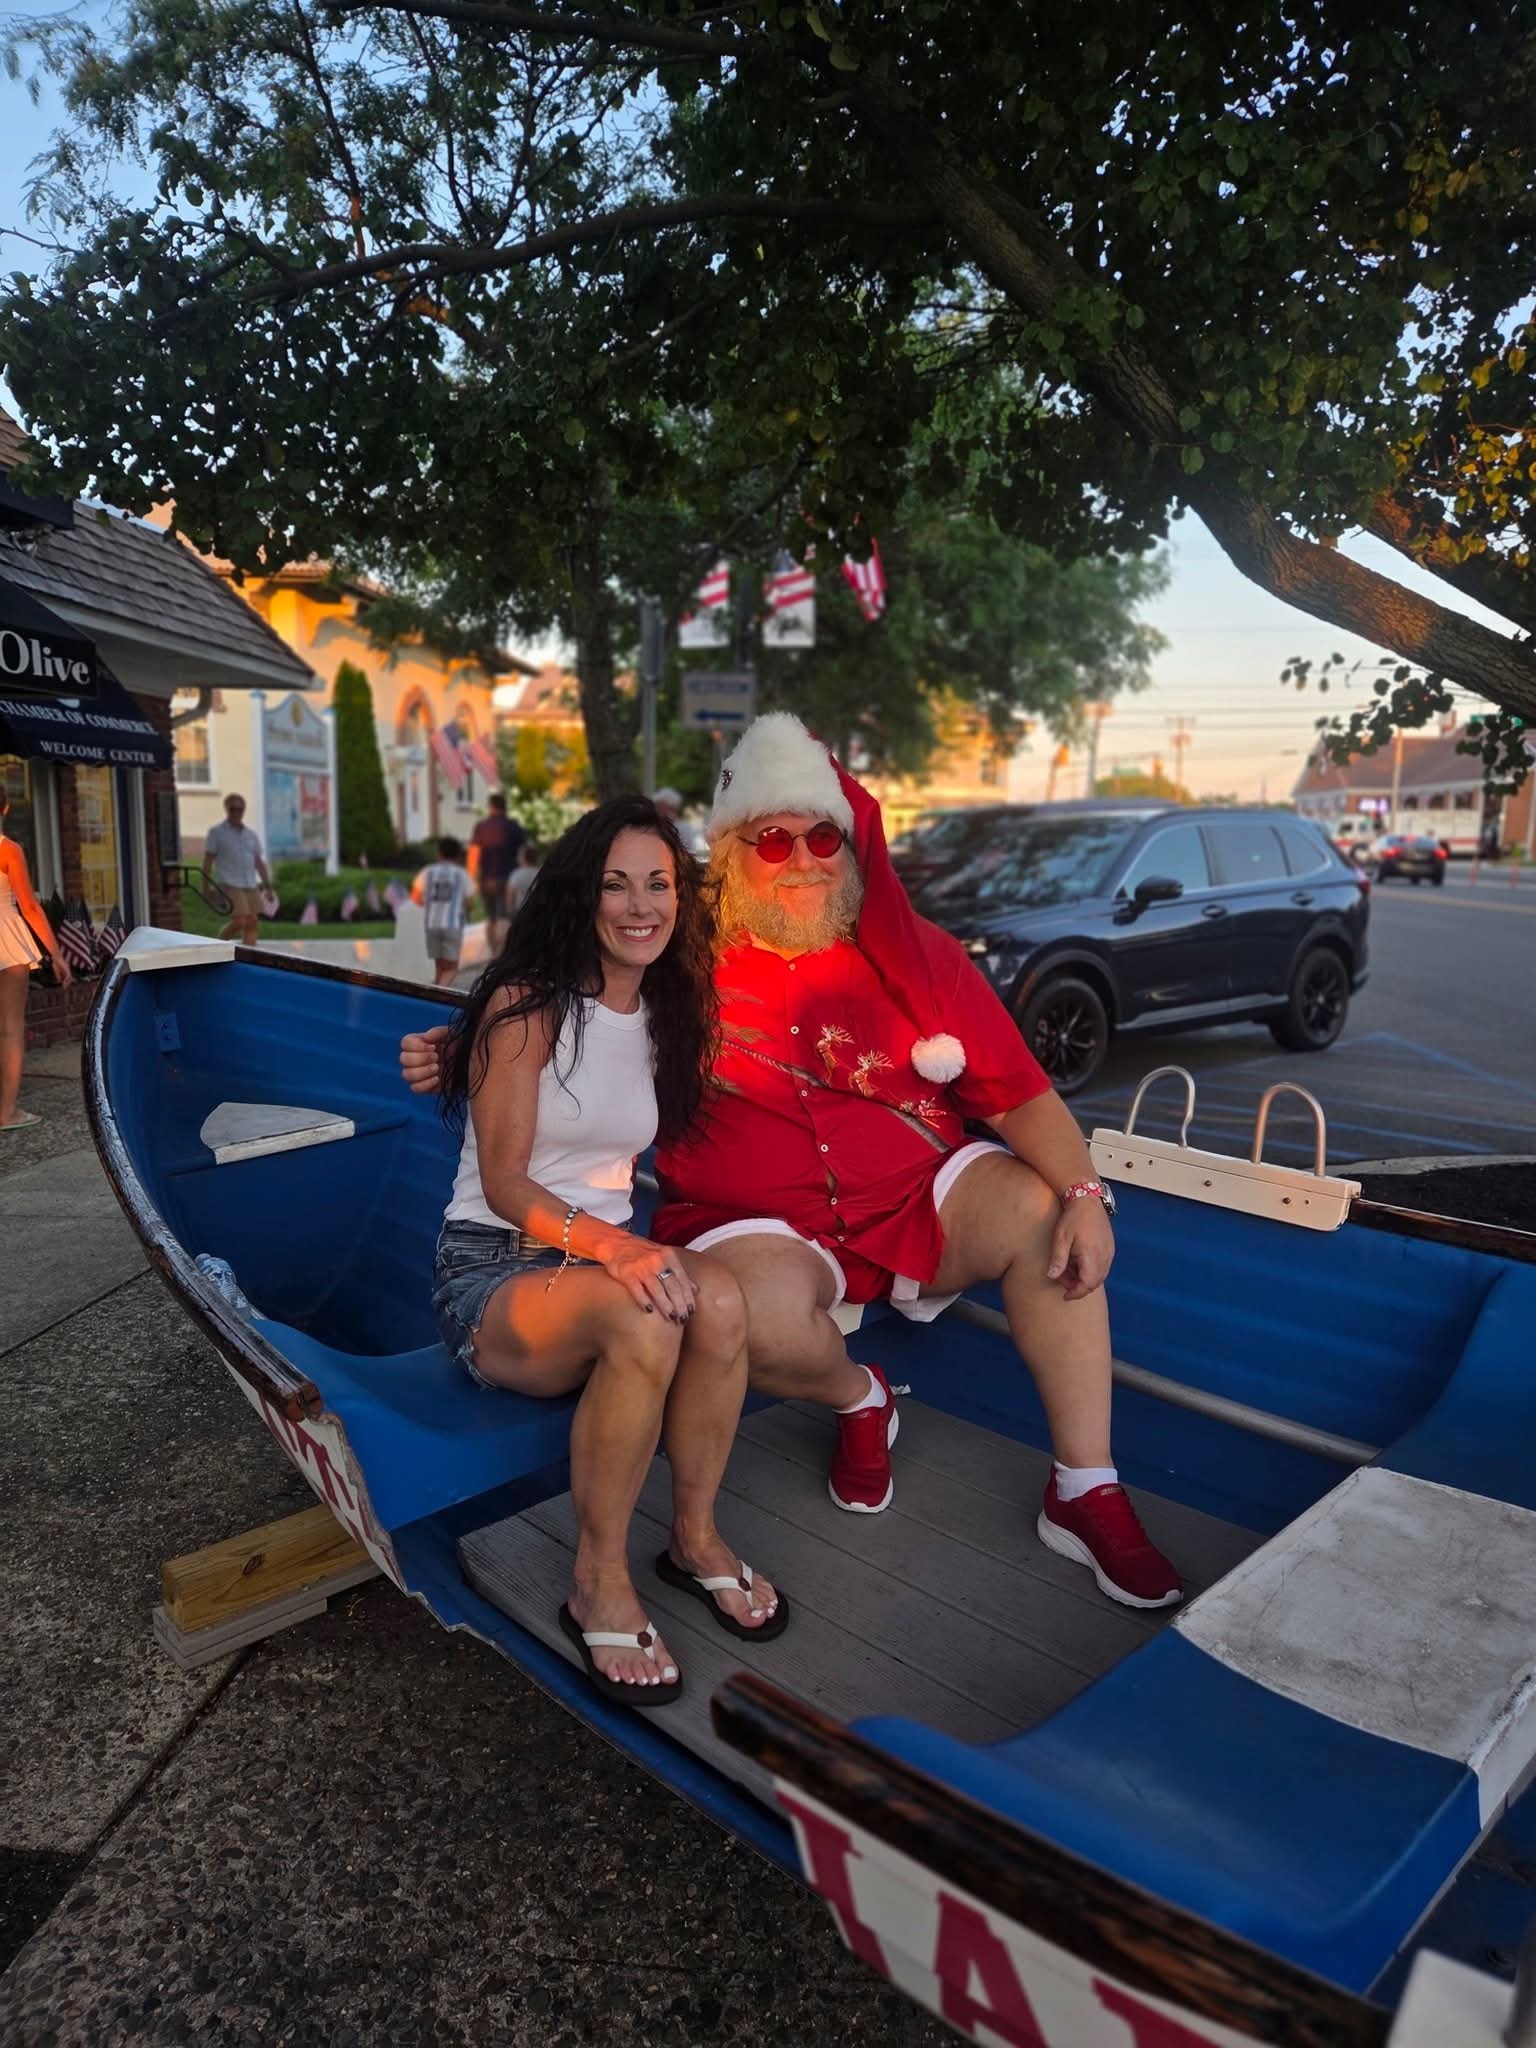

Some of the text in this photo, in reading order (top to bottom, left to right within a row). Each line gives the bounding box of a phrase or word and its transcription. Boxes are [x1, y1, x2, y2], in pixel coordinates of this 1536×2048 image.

[0, 630, 90, 684] Olive
[0, 699, 160, 737] CHAMBER OF COMMERCE
[40, 740, 155, 764] WELCOME CENTER
